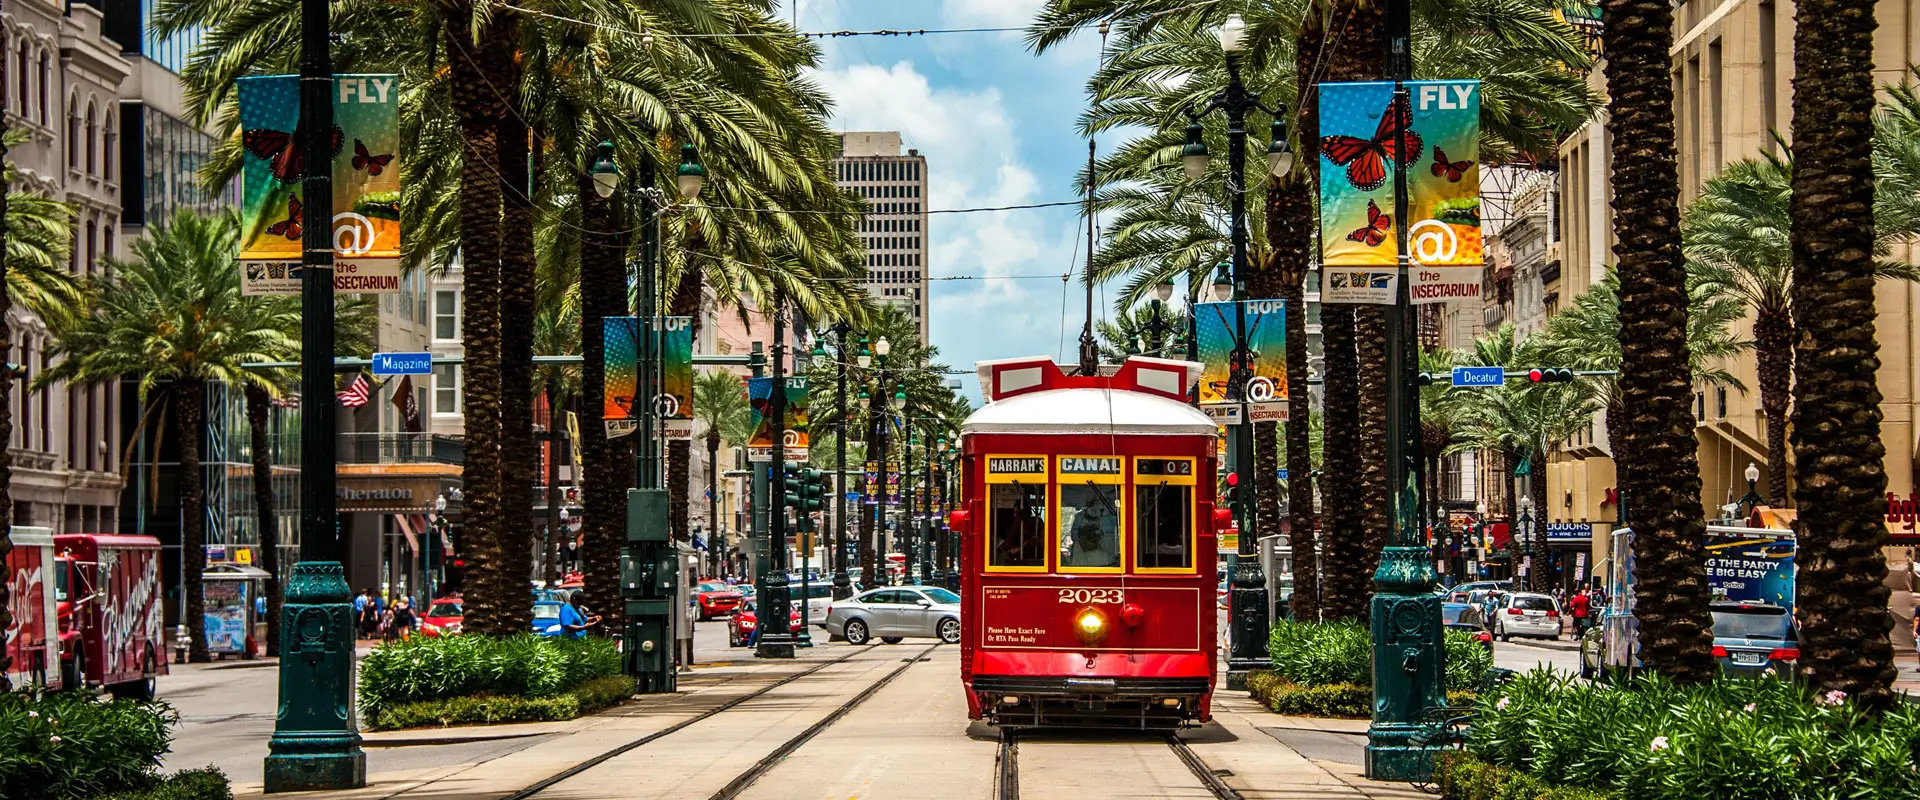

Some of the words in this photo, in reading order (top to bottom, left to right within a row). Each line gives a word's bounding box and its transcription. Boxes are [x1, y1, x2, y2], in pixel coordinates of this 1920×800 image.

[339, 78, 393, 104] FLY
[1419, 84, 1475, 111] FLY
[1407, 218, 1458, 265] @
[335, 261, 357, 273] the
[1419, 270, 1440, 281] the
[1411, 283, 1479, 299] INSECTARIUM
[1246, 301, 1284, 315] HOP
[382, 356, 430, 372] Magazine
[1464, 370, 1498, 383] Decatur
[786, 378, 807, 389] FLY
[990, 459, 1045, 472] HARRAH'S
[1062, 458, 1120, 471] CANAL
[336, 486, 413, 501] Sheraton
[1546, 522, 1590, 530] LIQUORS
[1718, 559, 1740, 568] THE
[1743, 560, 1780, 570] PARTY
[1716, 568, 1735, 577] BIG
[1738, 569, 1767, 579] EASY
[1058, 588, 1124, 604] 2023
[988, 626, 1003, 634] Please
[1004, 626, 1017, 634] Have
[1034, 627, 1046, 635] Fare
[987, 634, 994, 642] Or
[995, 634, 1007, 642] RTA
[1020, 635, 1036, 643] Ready
